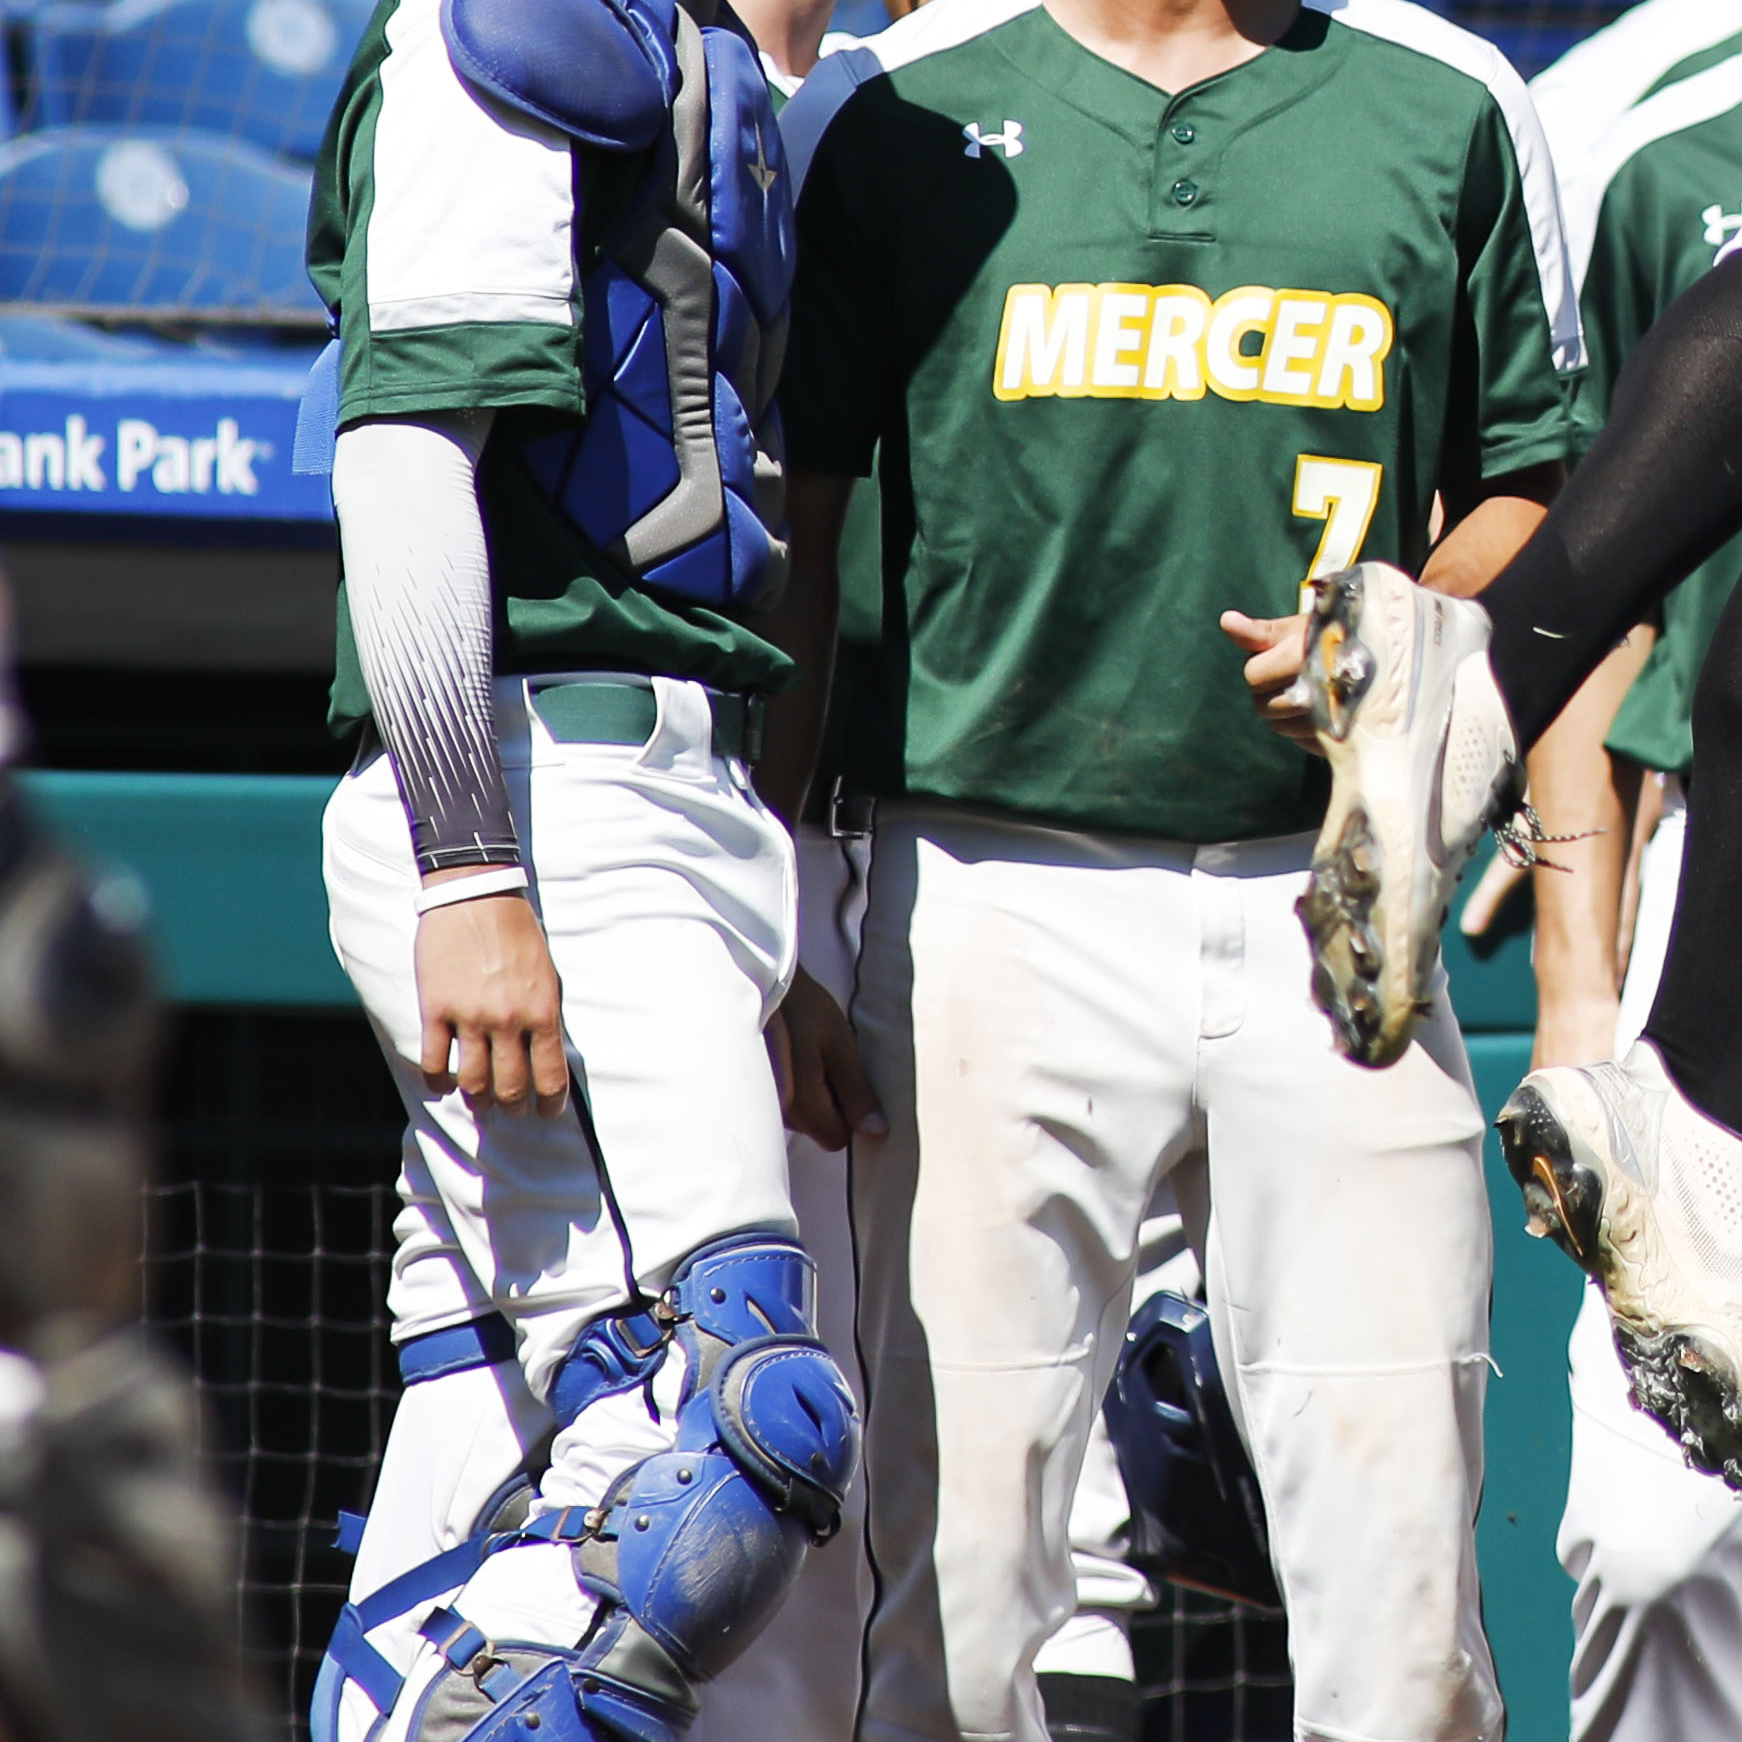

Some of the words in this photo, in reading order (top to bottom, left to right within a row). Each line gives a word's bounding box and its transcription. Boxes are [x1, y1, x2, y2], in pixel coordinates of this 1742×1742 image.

[992, 283, 1393, 412] MERCER
[116, 418, 259, 496] Park
[1291, 454, 1383, 616] 7
